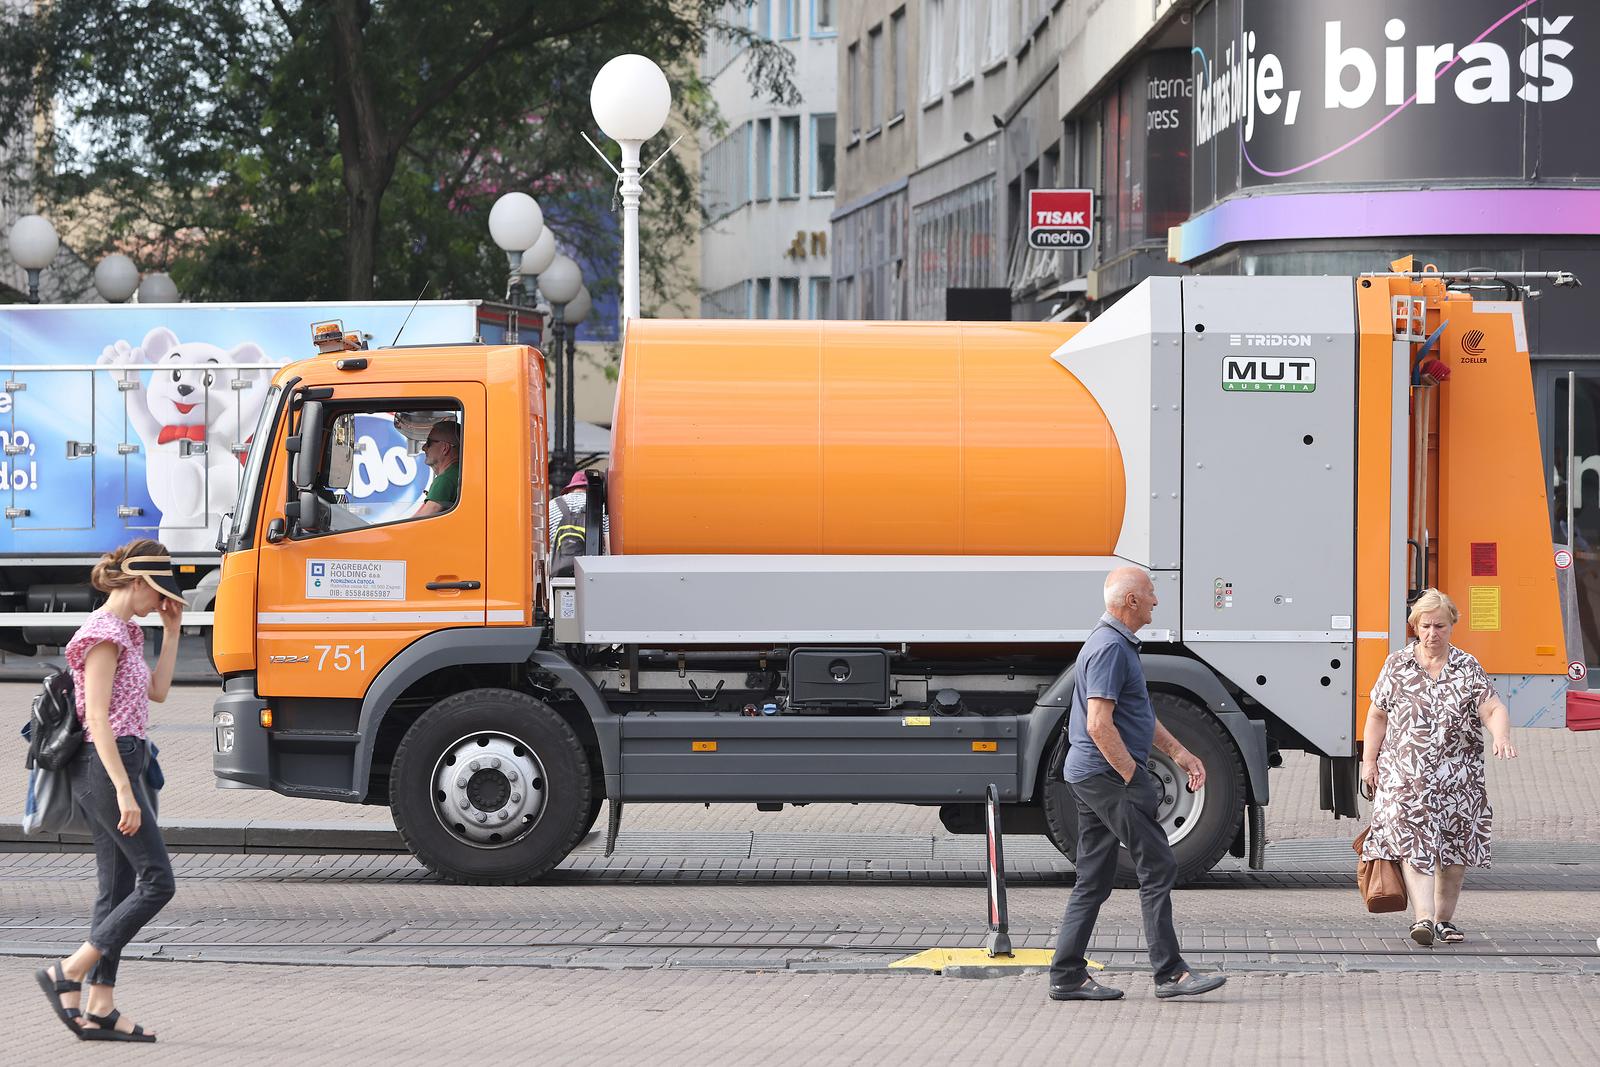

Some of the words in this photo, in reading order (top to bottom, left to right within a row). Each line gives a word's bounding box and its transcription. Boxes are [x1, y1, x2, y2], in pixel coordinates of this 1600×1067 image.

[1196, 60, 1212, 146] Kad
[1213, 48, 1230, 136] znaš
[1231, 31, 1301, 142] bolje,
[1324, 16, 1574, 109] biraš
[1036, 211, 1085, 225] TISAK
[1037, 230, 1084, 244] media
[1228, 361, 1310, 380] MUT
[330, 562, 382, 571] ZAGREBAČKI
[330, 570, 367, 578] HOLDING
[345, 589, 391, 597] 85584865987
[269, 655, 310, 664] 1324
[314, 645, 365, 671] 751
